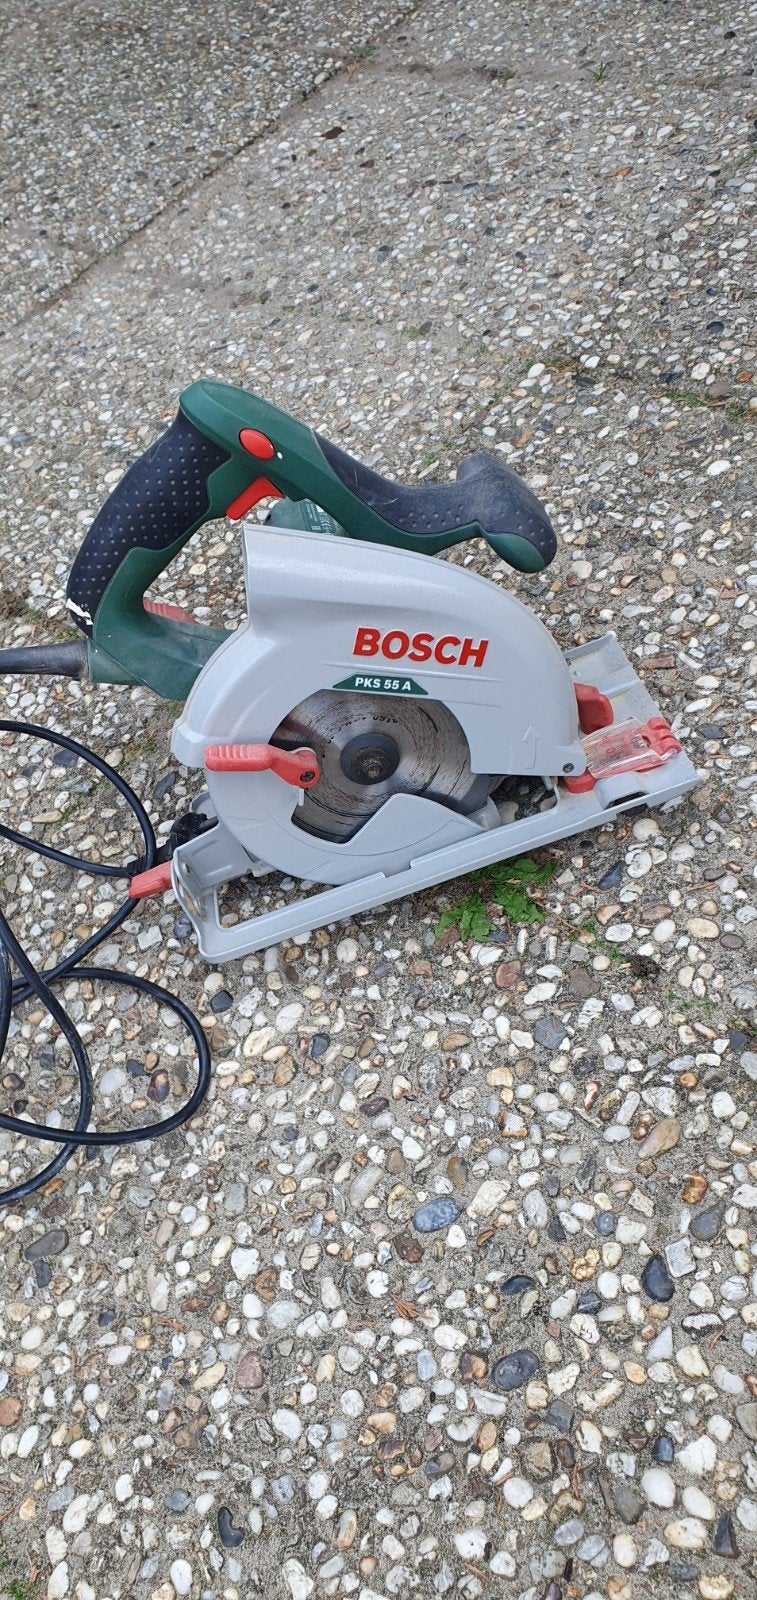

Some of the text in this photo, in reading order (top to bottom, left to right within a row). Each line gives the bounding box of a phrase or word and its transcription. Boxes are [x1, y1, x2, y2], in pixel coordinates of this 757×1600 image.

[353, 627, 489, 668] BOSCH
[355, 677, 412, 691] PKS 55 A
